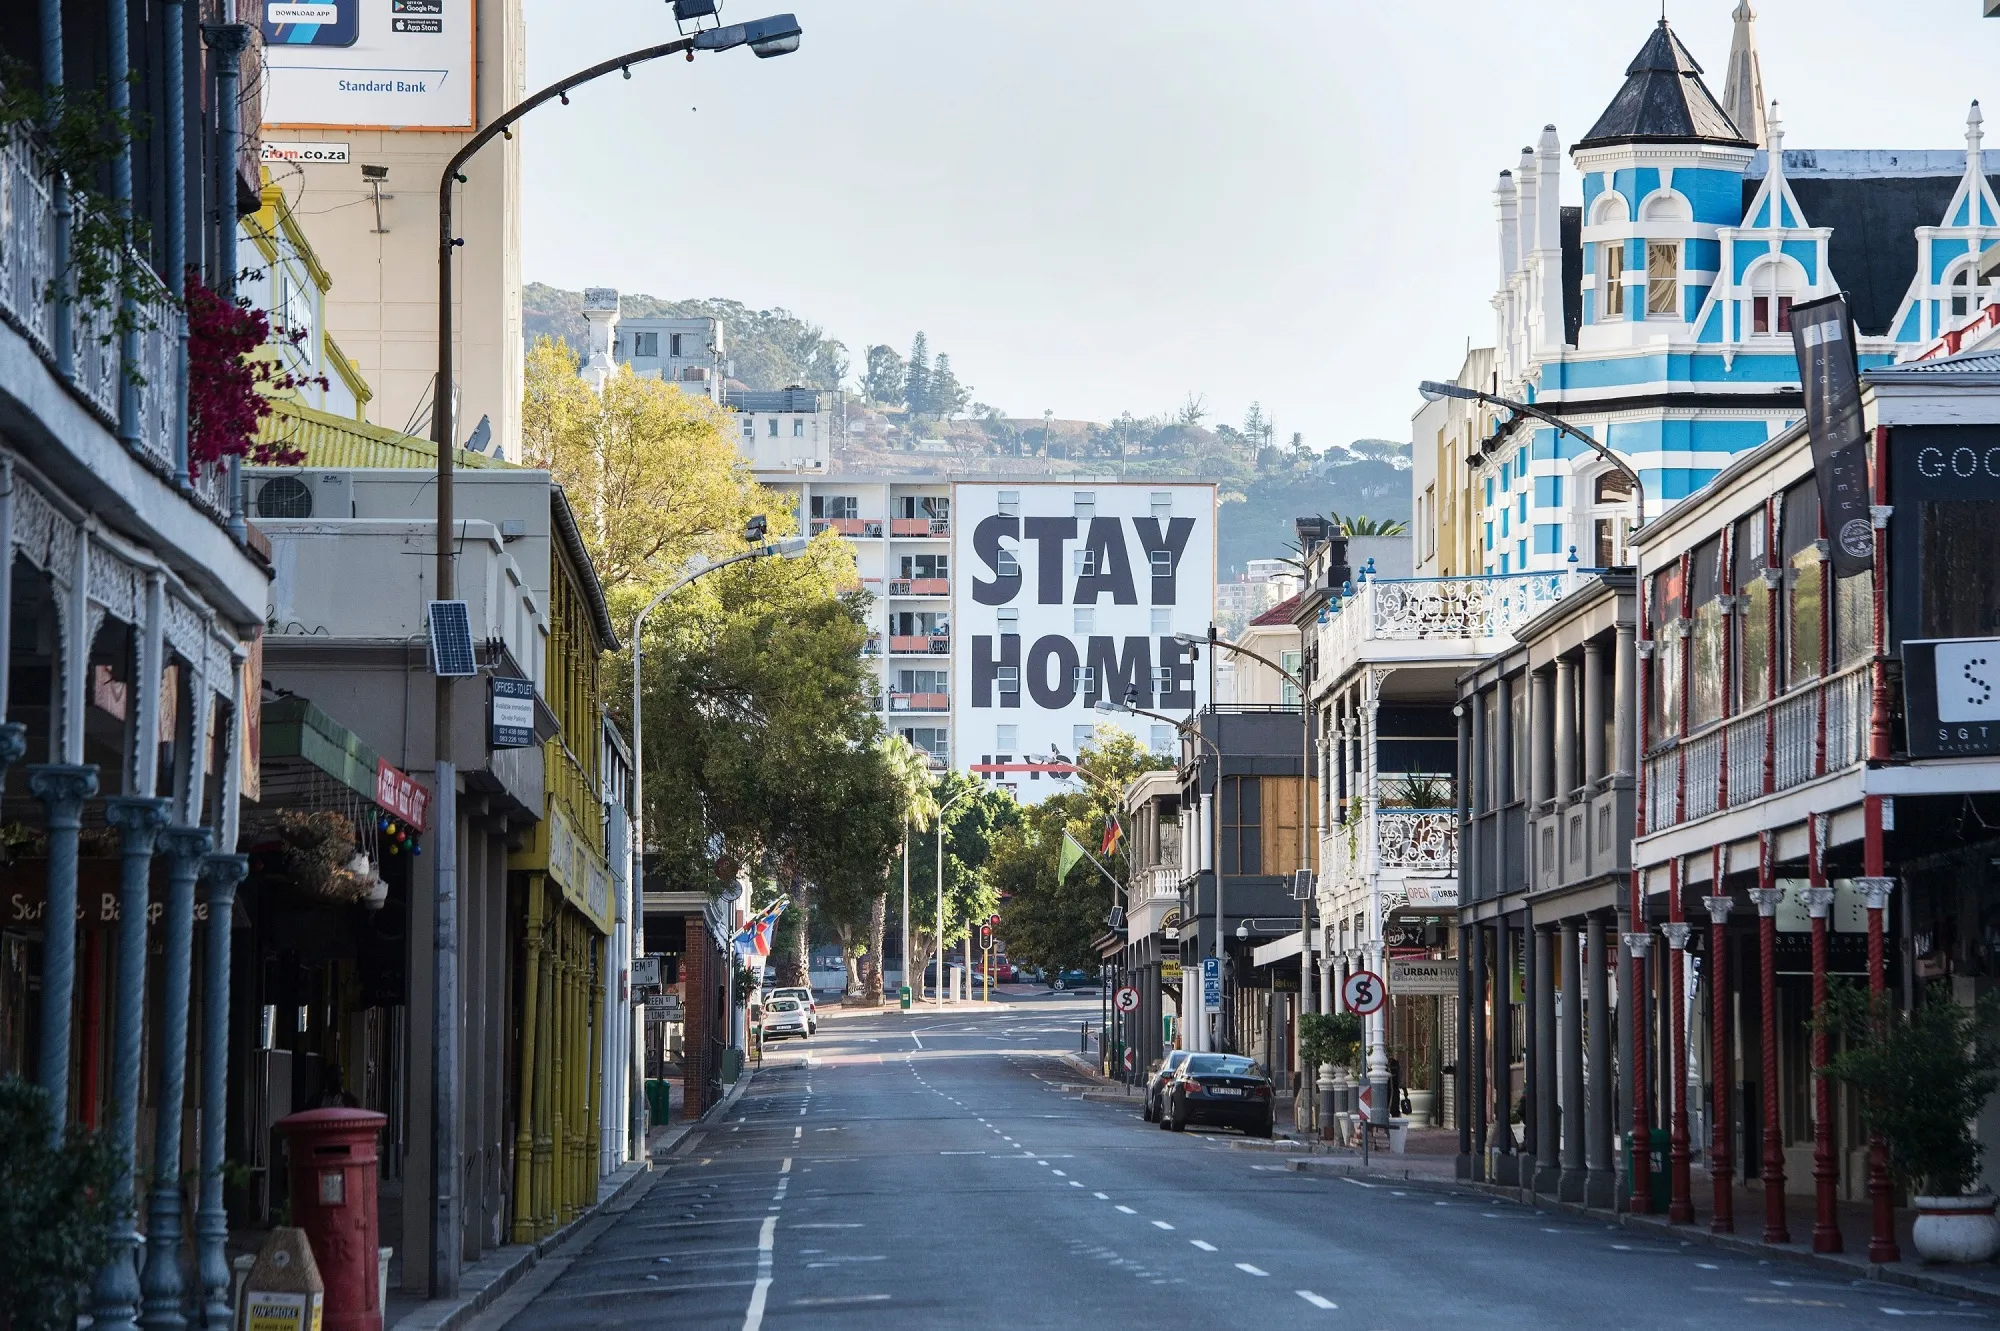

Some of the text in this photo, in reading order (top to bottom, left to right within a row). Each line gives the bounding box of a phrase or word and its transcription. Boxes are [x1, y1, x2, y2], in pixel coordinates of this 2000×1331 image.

[406, 4, 439, 13] Google Play
[406, 24, 439, 32] App Store
[339, 80, 426, 93] Standard Bank
[971, 511, 1197, 606] STAY
[971, 634, 1196, 710] HOME
[495, 682, 514, 693] OFFICES
[517, 683, 524, 695] TO
[524, 684, 533, 695] LET
[981, 754, 1012, 780] IF
[1408, 887, 1430, 899] OPEN
[1207, 961, 1215, 970] P
[1403, 967, 1438, 976] URBAN
[1122, 991, 1133, 1007] S
[1355, 980, 1374, 1005] S
[651, 1011, 665, 1020] LONG
[253, 1305, 298, 1320] UNSMOKE
